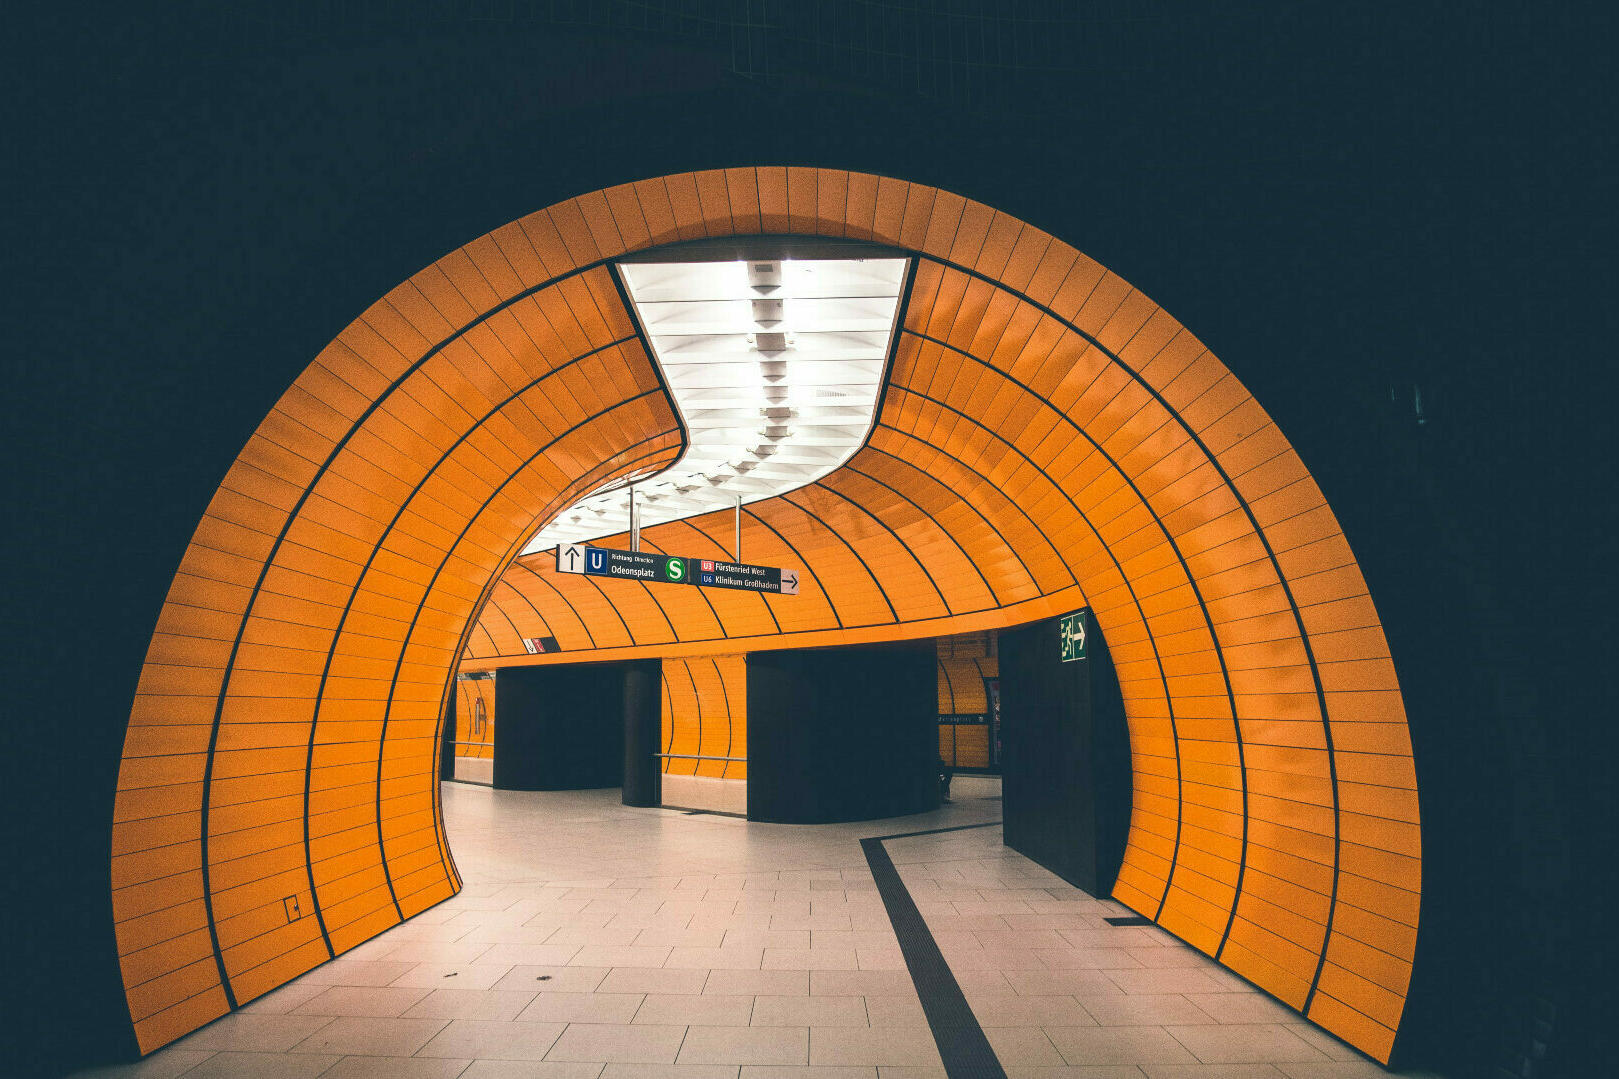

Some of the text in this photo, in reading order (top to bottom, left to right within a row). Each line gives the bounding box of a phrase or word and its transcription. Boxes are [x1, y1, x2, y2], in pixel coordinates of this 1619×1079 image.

[592, 553, 602, 569] U
[611, 565, 655, 578] Odeonsplatz
[668, 561, 682, 579] S
[703, 562, 766, 576] U3 Fürstenried West
[703, 575, 712, 583] U6
[715, 575, 743, 586] Klinikum
